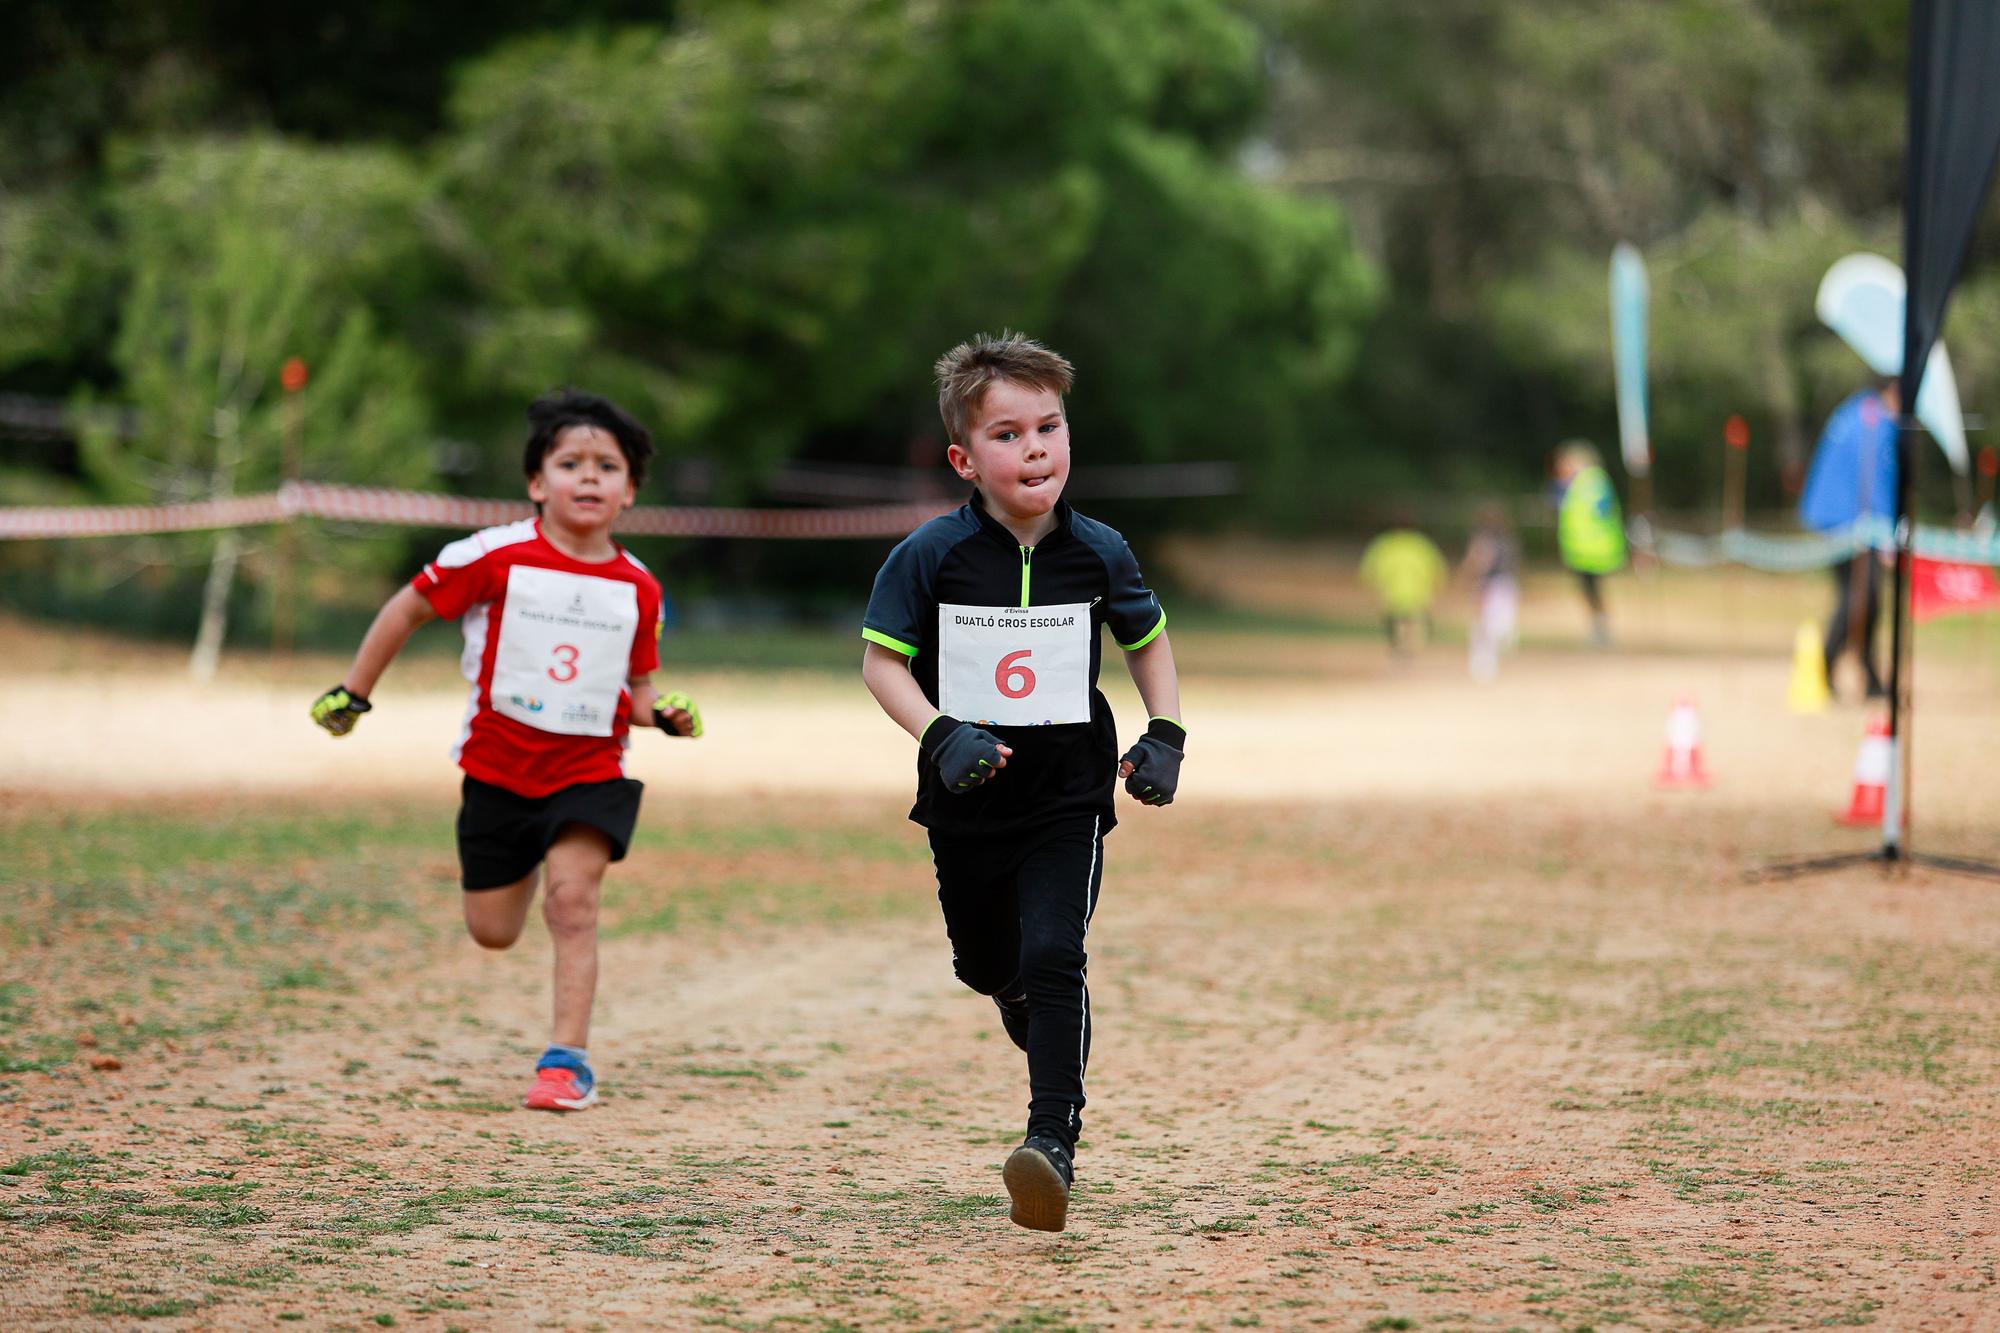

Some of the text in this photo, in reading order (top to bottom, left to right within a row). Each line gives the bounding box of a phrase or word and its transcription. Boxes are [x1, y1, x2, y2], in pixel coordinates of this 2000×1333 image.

[955, 615, 1075, 628] DUATLÓ CROS ESCOLAR
[548, 644, 580, 682] 3
[995, 650, 1036, 699] 6
